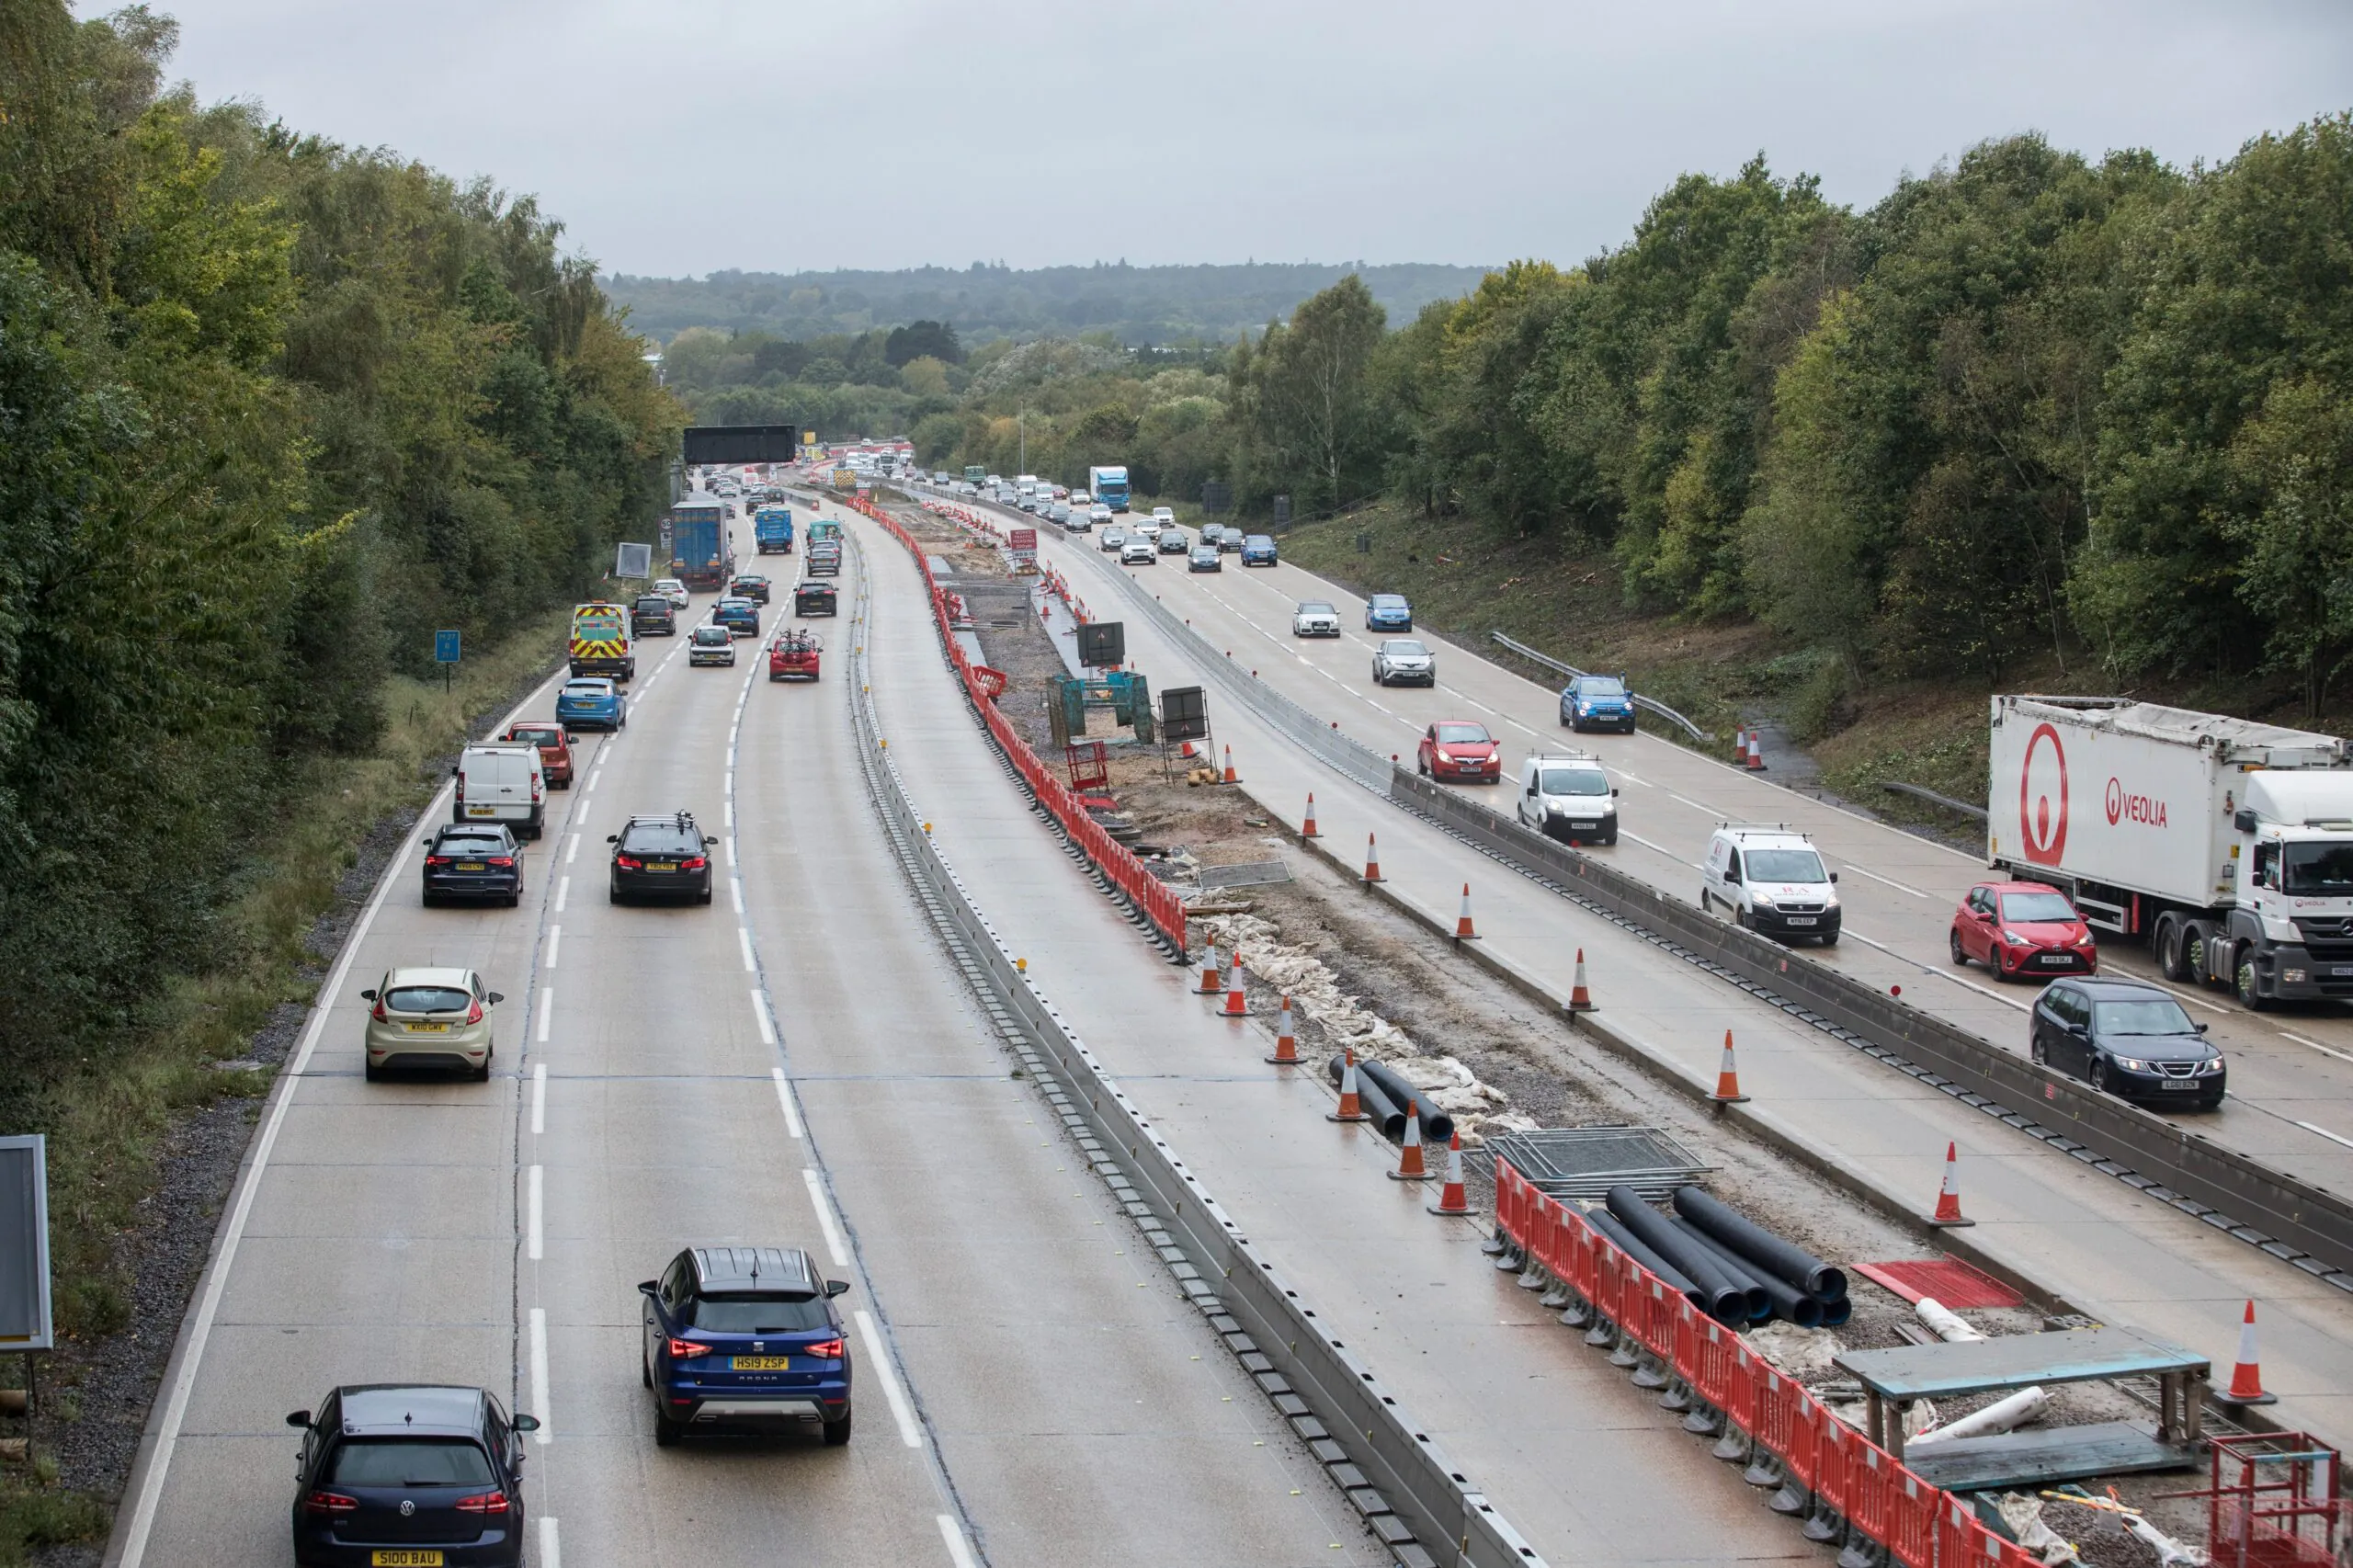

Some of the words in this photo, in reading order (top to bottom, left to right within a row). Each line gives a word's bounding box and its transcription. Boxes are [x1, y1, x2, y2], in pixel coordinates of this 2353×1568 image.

[2123, 792, 2167, 828] VEOLIA
[736, 1358, 761, 1369] HS19
[764, 1358, 785, 1369] ZSP
[380, 1551, 408, 1564] S100
[411, 1551, 437, 1564] BAU
